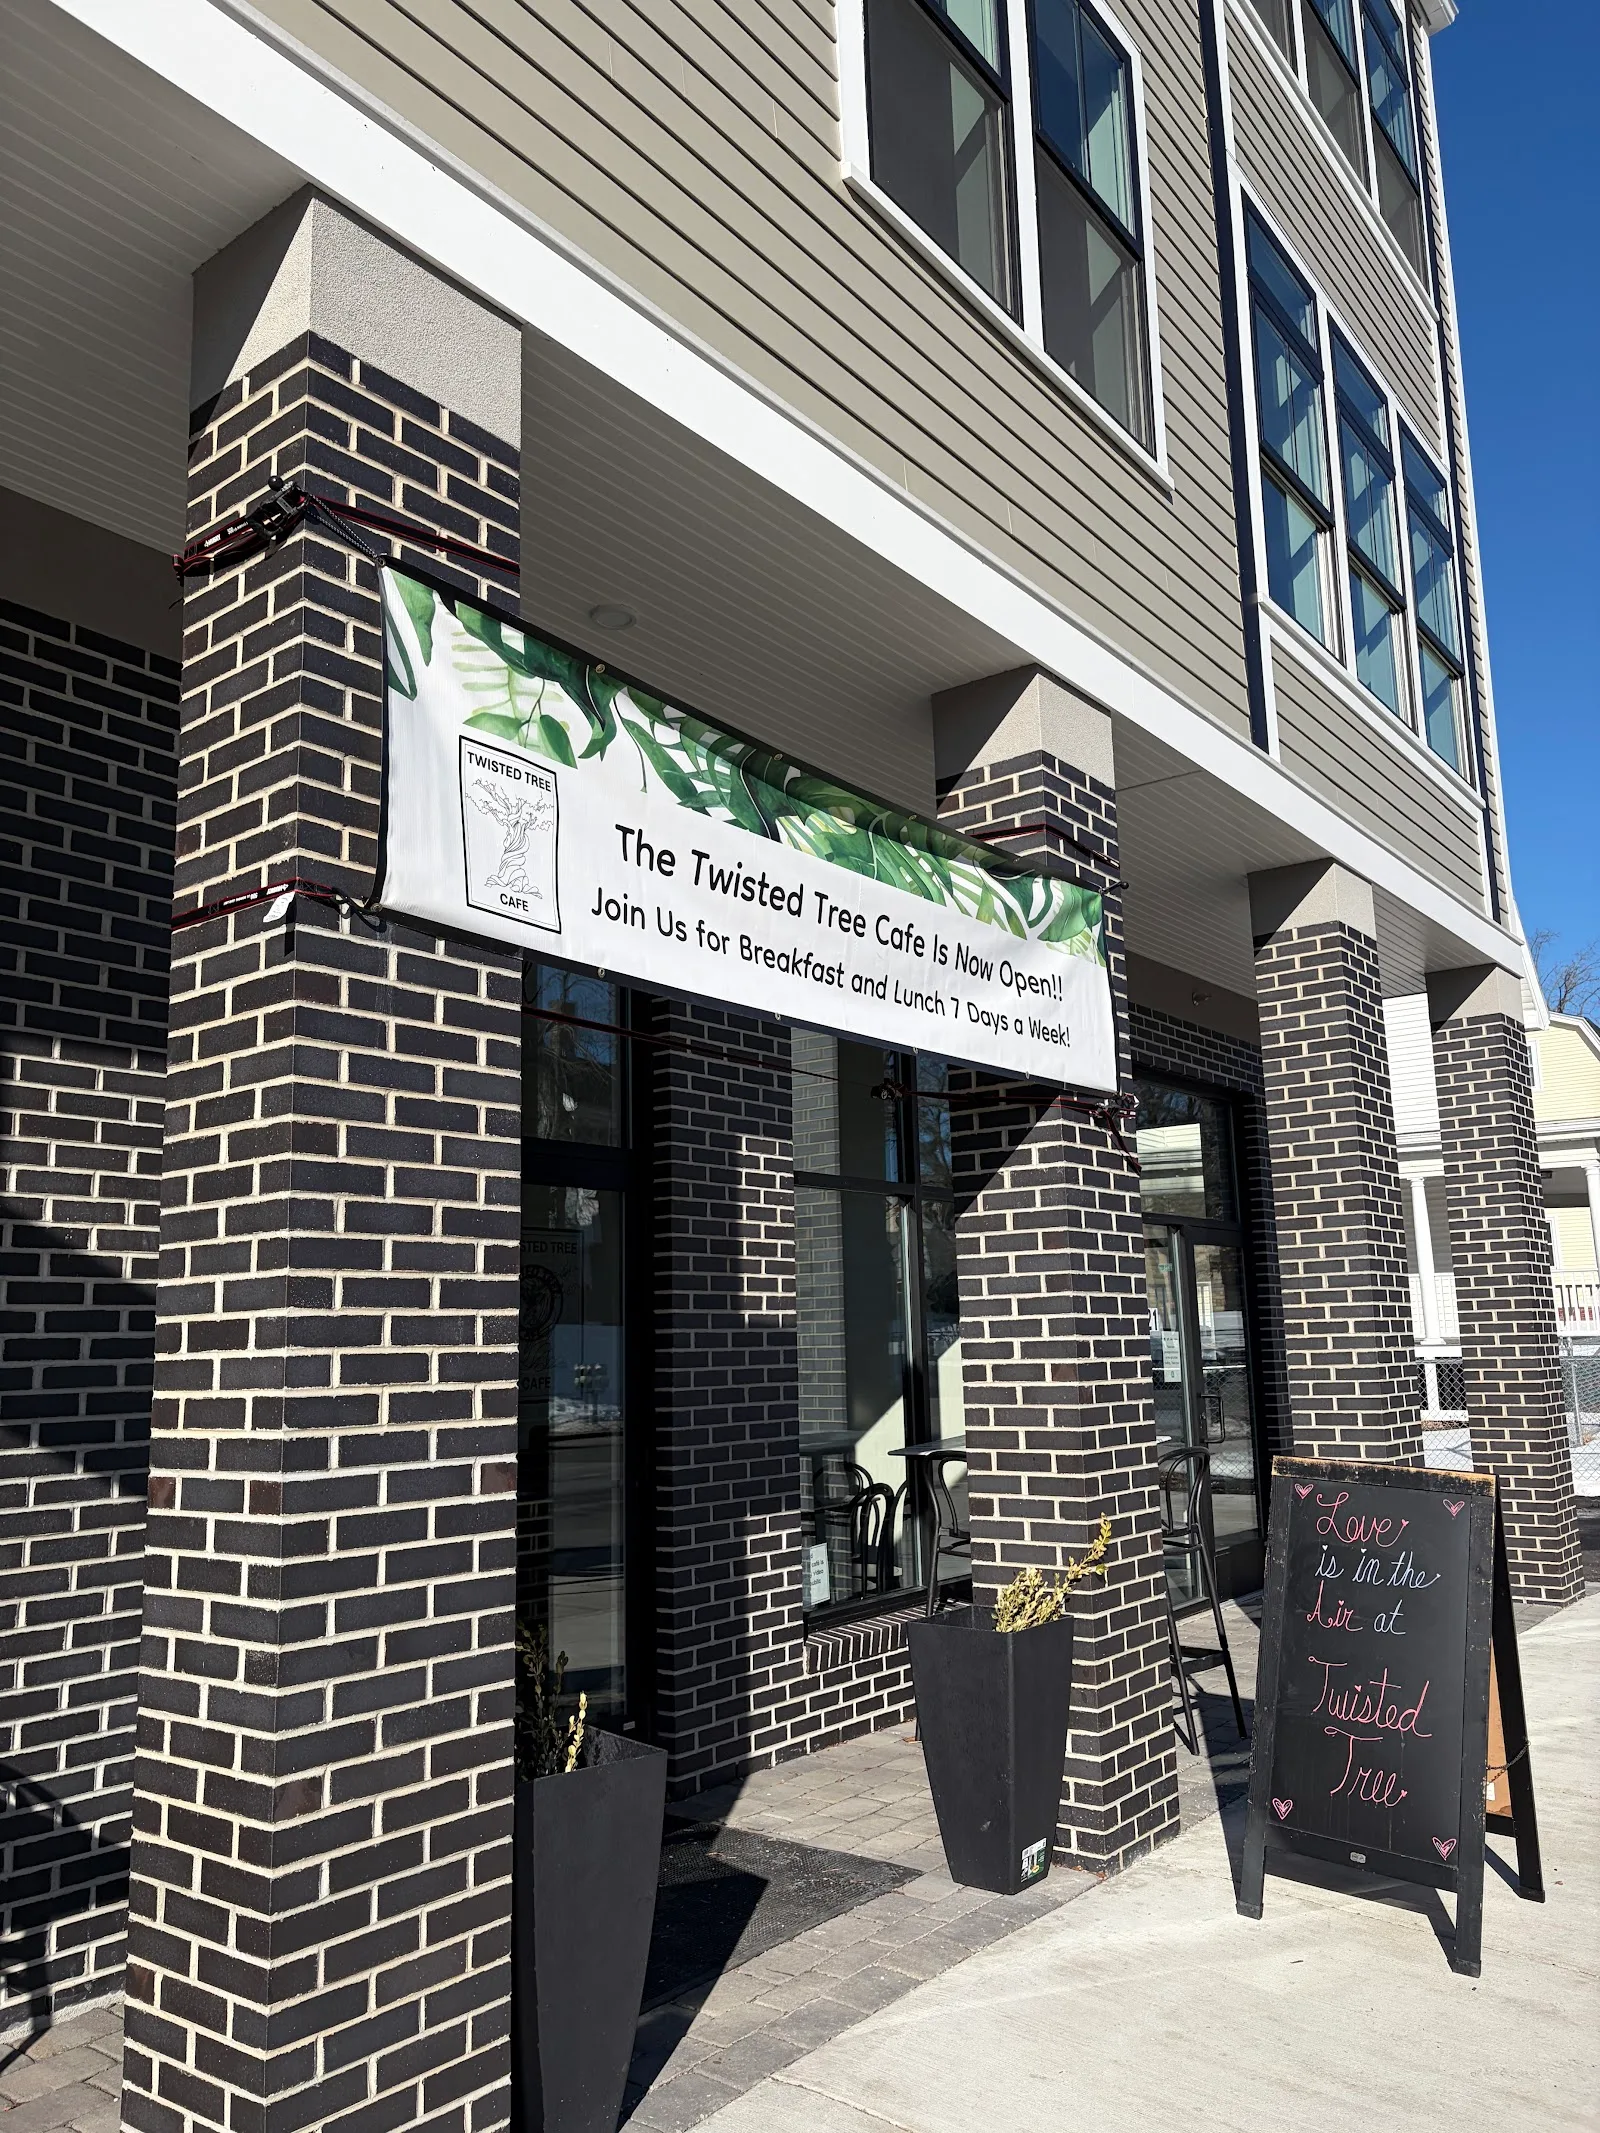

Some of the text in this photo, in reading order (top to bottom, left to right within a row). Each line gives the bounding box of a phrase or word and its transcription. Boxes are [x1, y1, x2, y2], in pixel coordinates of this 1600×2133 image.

[467, 751, 552, 793] TWISTED TREE
[499, 893, 529, 912] CAFE
[615, 824, 1063, 1001] The Twisted Tree Cafe Is Now Open!!
[591, 886, 1071, 1047] Join Us for Breakfast and Lunch 7 Days a Week!
[520, 1239, 578, 1255] STED TREE
[522, 1376, 551, 1390] CAFE
[1315, 1491, 1409, 1548] Love
[1315, 1544, 1441, 1589] is in the
[1306, 1579, 1406, 1636] Air at
[1308, 1655, 1432, 1738] Twisted
[1324, 1726, 1408, 1807] Tree
